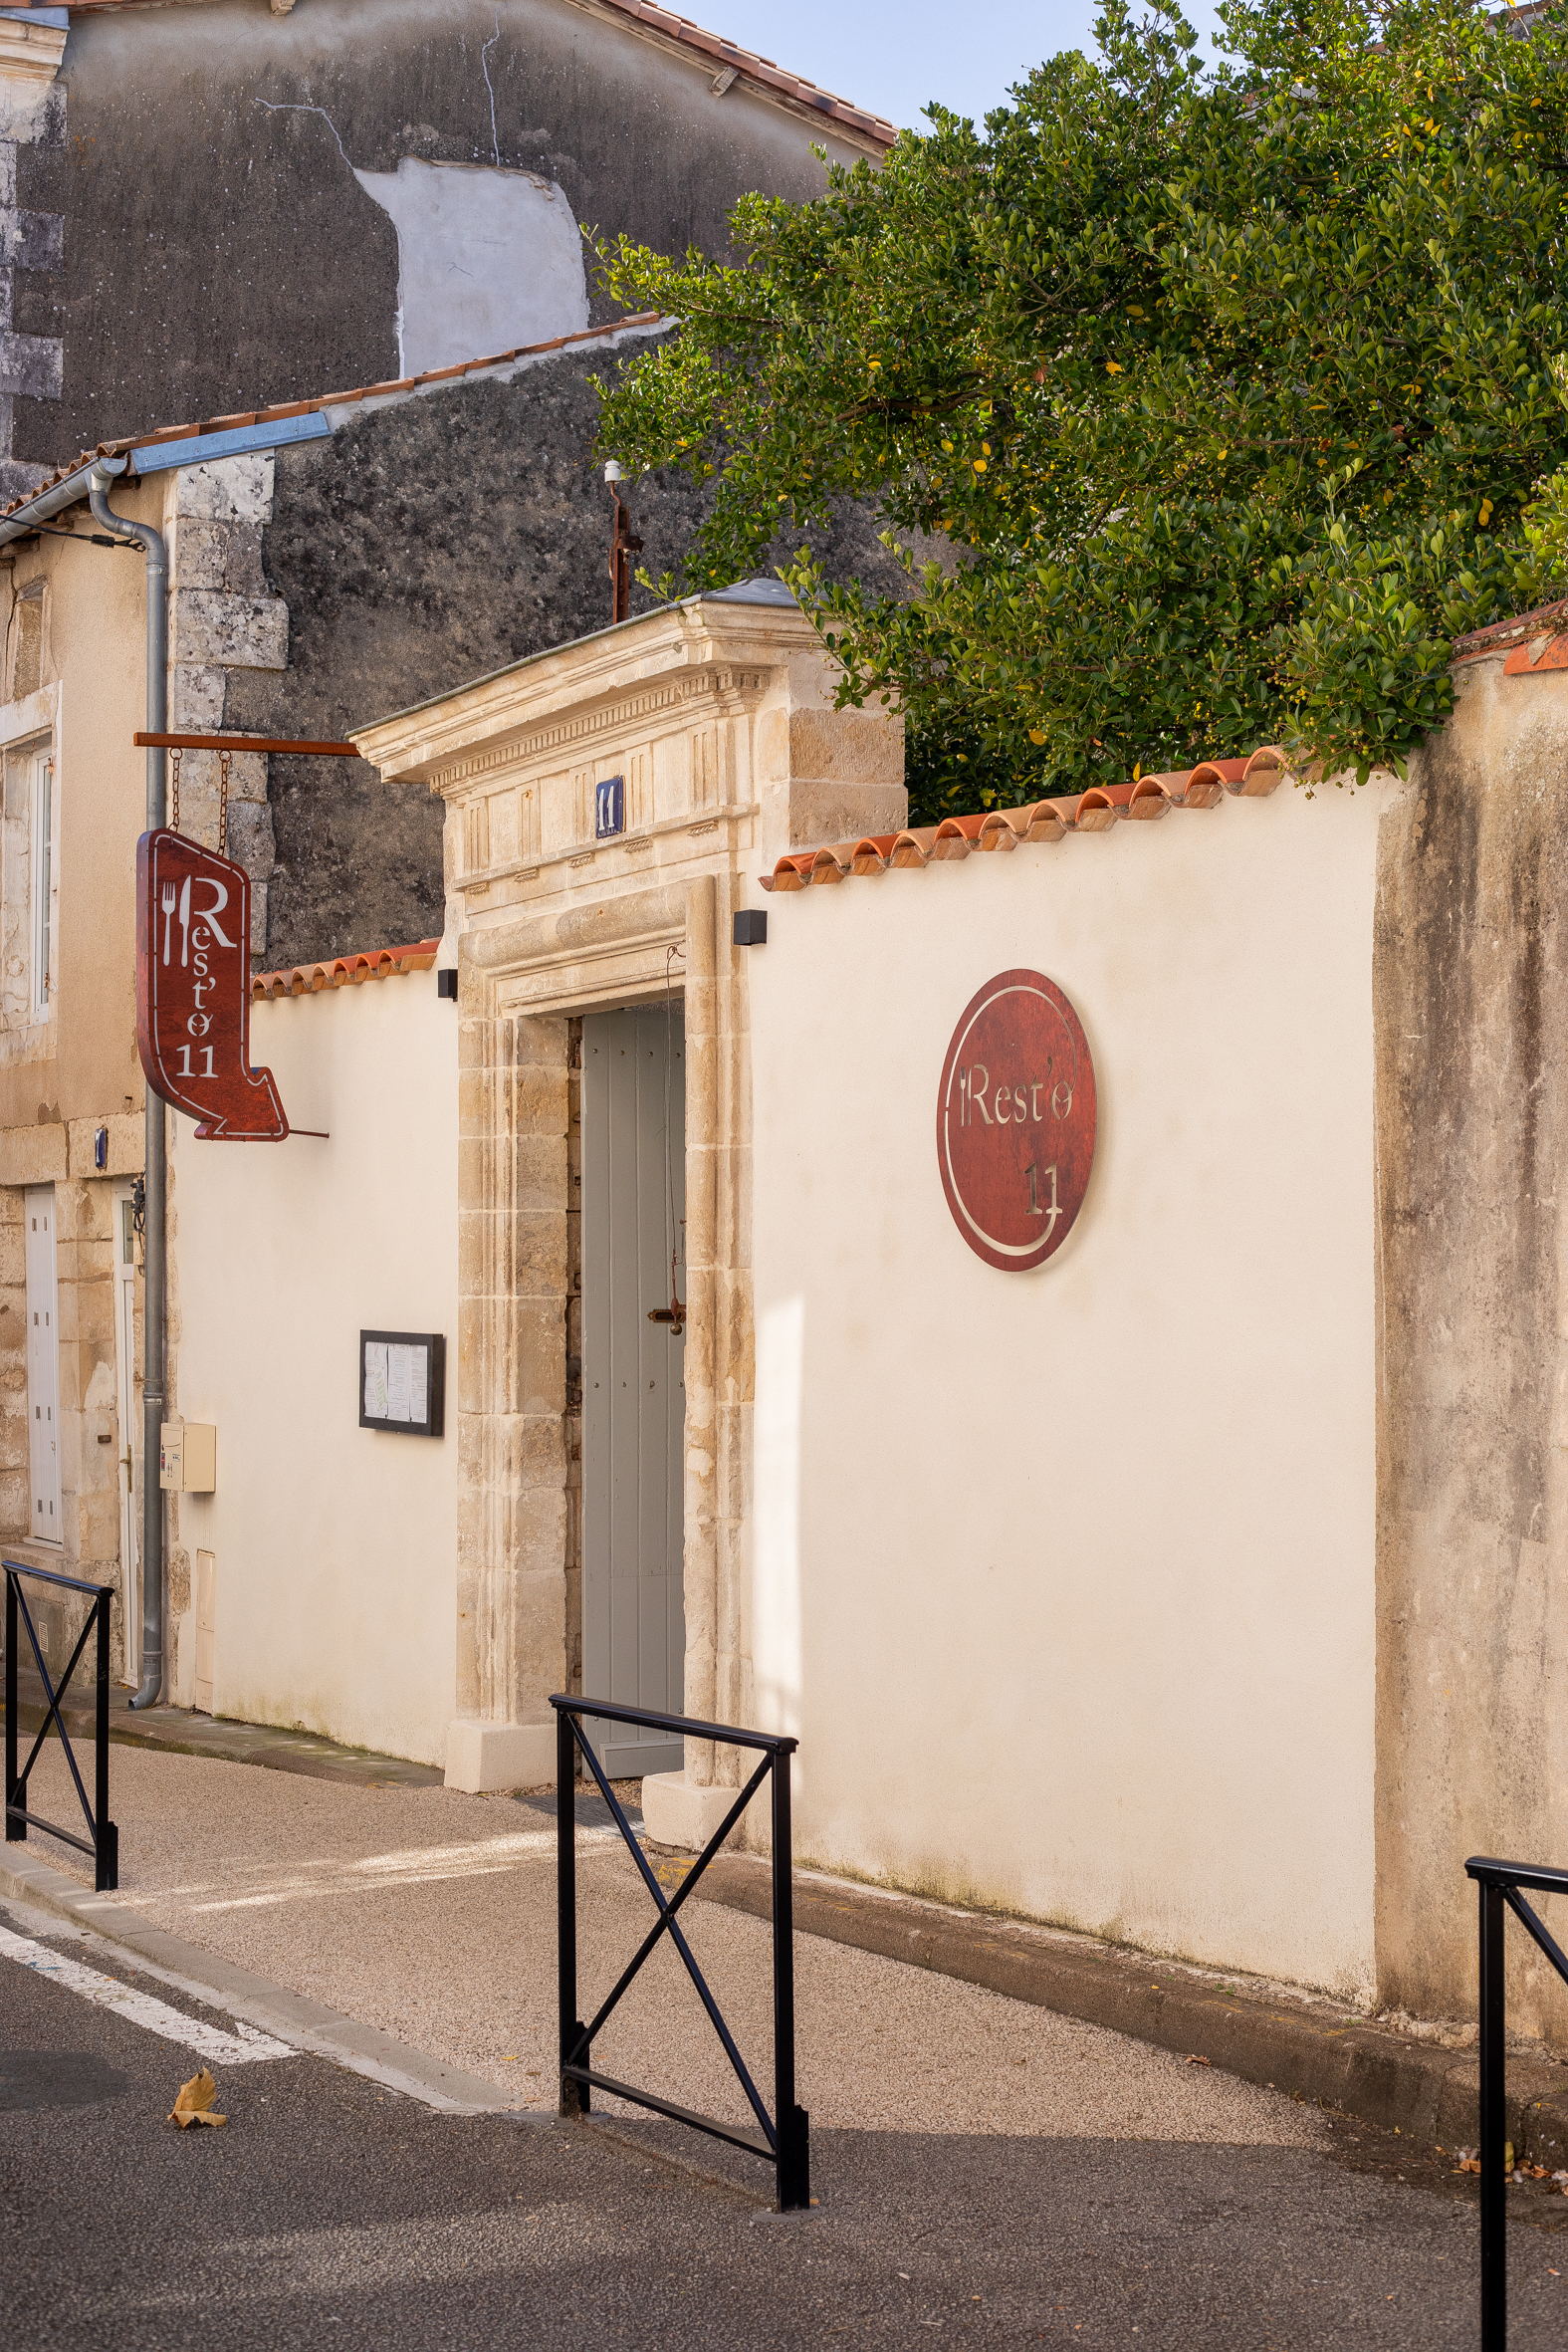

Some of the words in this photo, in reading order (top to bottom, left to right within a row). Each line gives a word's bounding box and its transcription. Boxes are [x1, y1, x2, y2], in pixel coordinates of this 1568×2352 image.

[598, 785, 615, 831] 11
[175, 1044, 219, 1078] 11
[1023, 1161, 1063, 1215] 11
